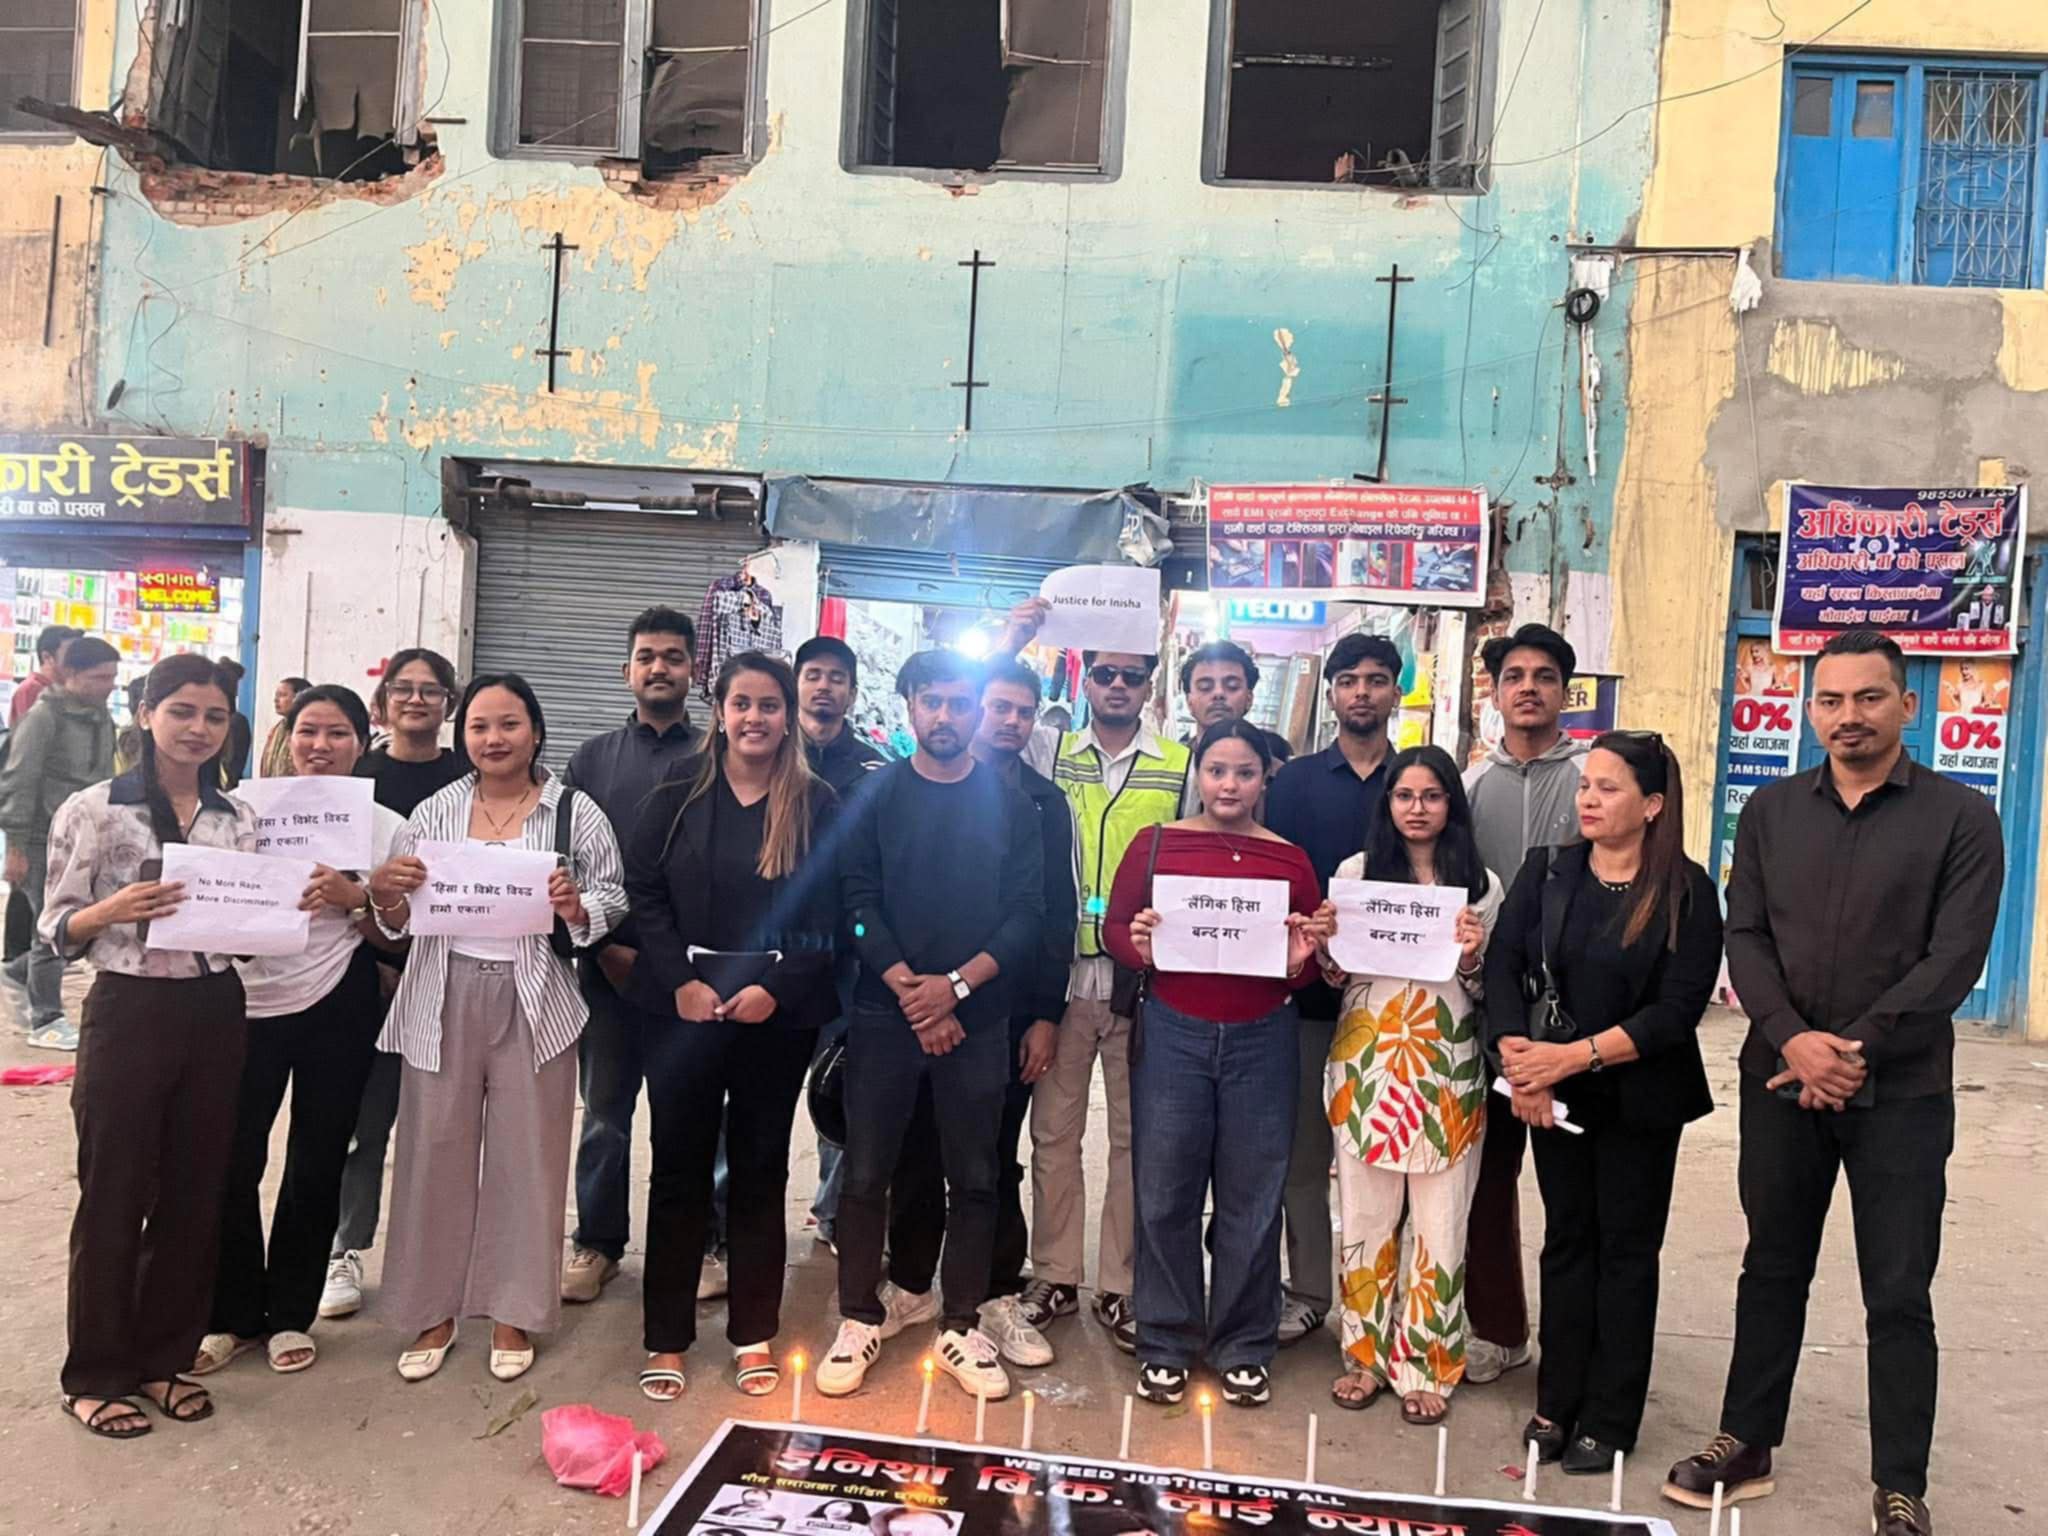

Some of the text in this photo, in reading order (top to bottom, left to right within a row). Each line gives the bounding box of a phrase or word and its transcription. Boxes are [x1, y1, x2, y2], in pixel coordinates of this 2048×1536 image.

[0, 442, 95, 496] कारी
[38, 497, 60, 516] को
[64, 501, 106, 518] पसल
[1797, 500, 1928, 539] अधिकारी
[1797, 548, 1870, 571] अधिकारी
[1053, 595, 1142, 609] Justice for Inisha
[1733, 698, 1793, 733] 0%
[1941, 716, 2002, 751] 0%
[1728, 763, 1790, 777] SAMSUNG
[198, 878, 212, 886] No
[215, 879, 235, 888] More
[196, 894, 219, 903] More
[223, 895, 280, 907] Discrimination
[1191, 925, 1220, 940] बन्द
[1369, 928, 1398, 943] बन्द
[775, 1446, 956, 1486] इनिशा
[1003, 1457, 1346, 1507] WE NEED JUSTICE FOR ALL
